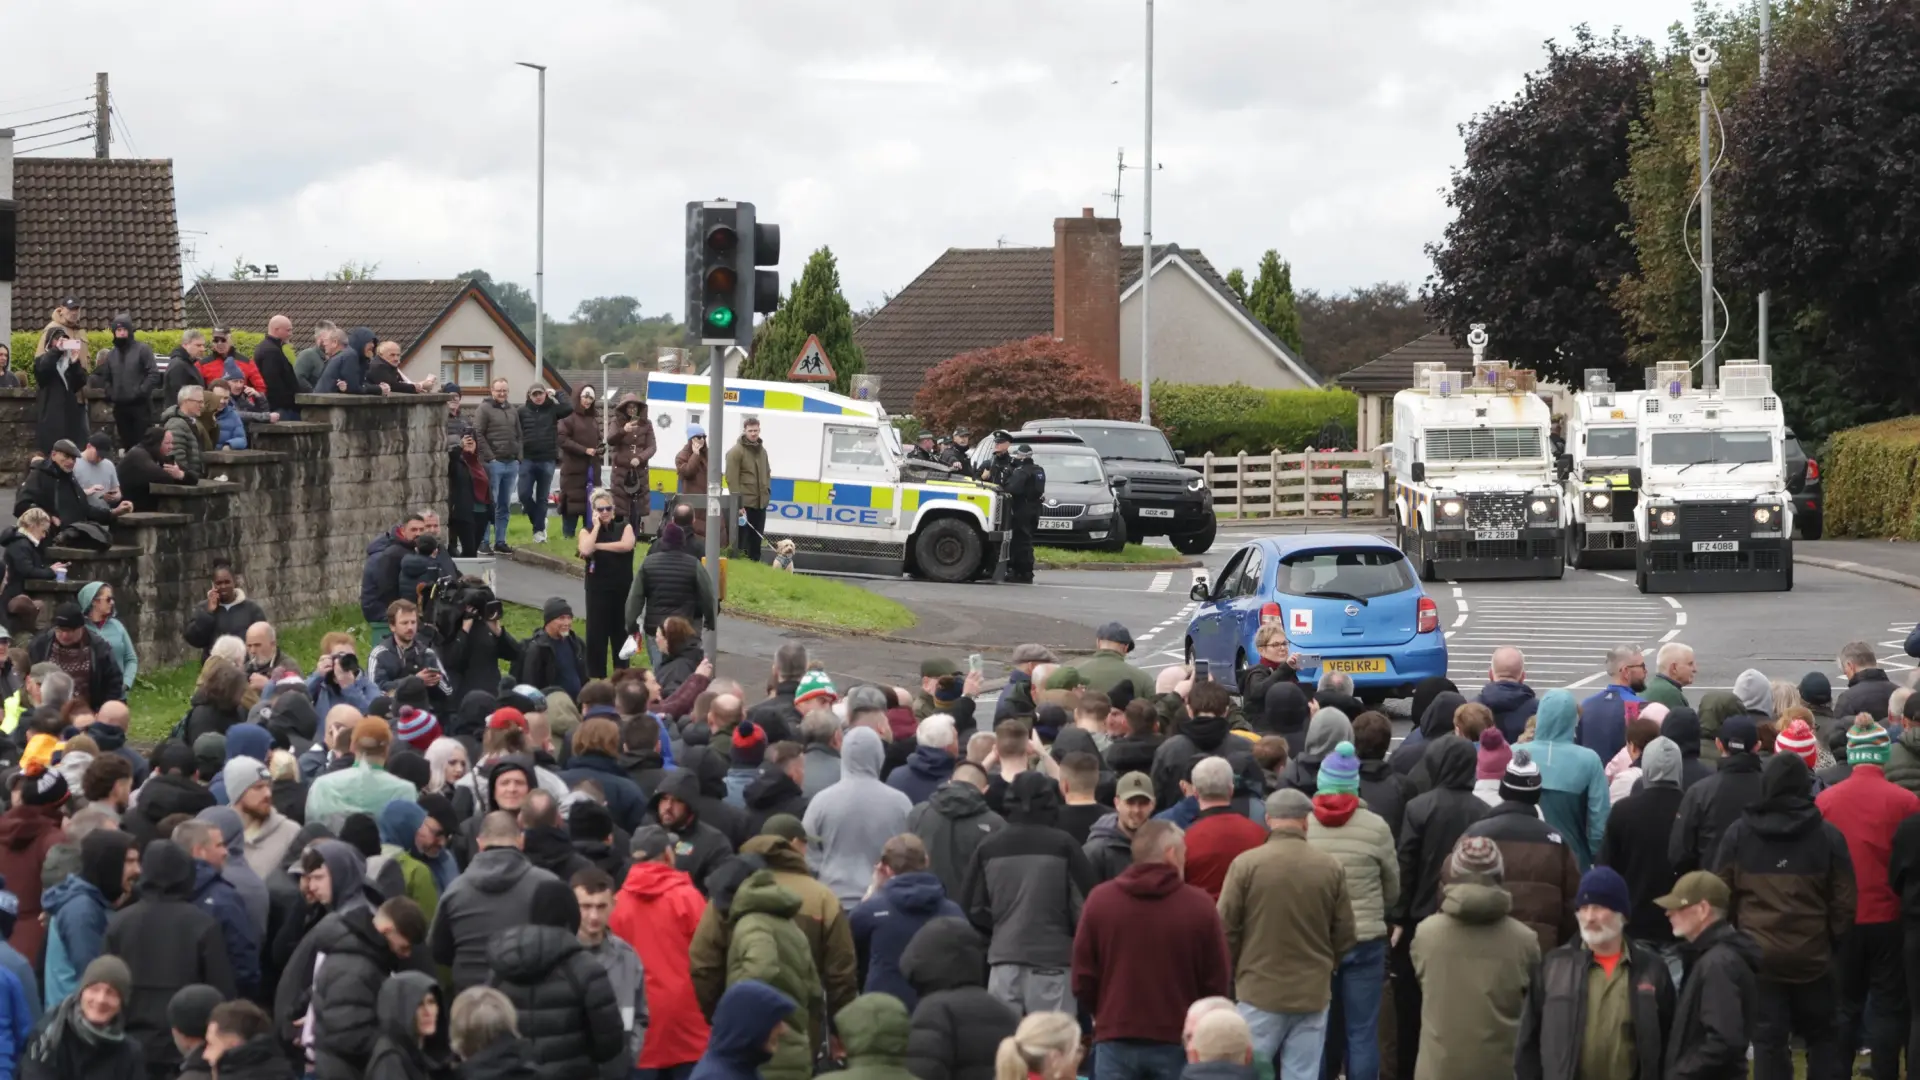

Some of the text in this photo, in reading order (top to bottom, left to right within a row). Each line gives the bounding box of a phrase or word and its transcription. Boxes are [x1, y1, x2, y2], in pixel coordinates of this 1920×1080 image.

[1051, 521, 1070, 529] 3643
[1696, 542, 1710, 551] IFZ
[1295, 613, 1307, 627] L
[1329, 660, 1379, 672] VE61 KRJ
